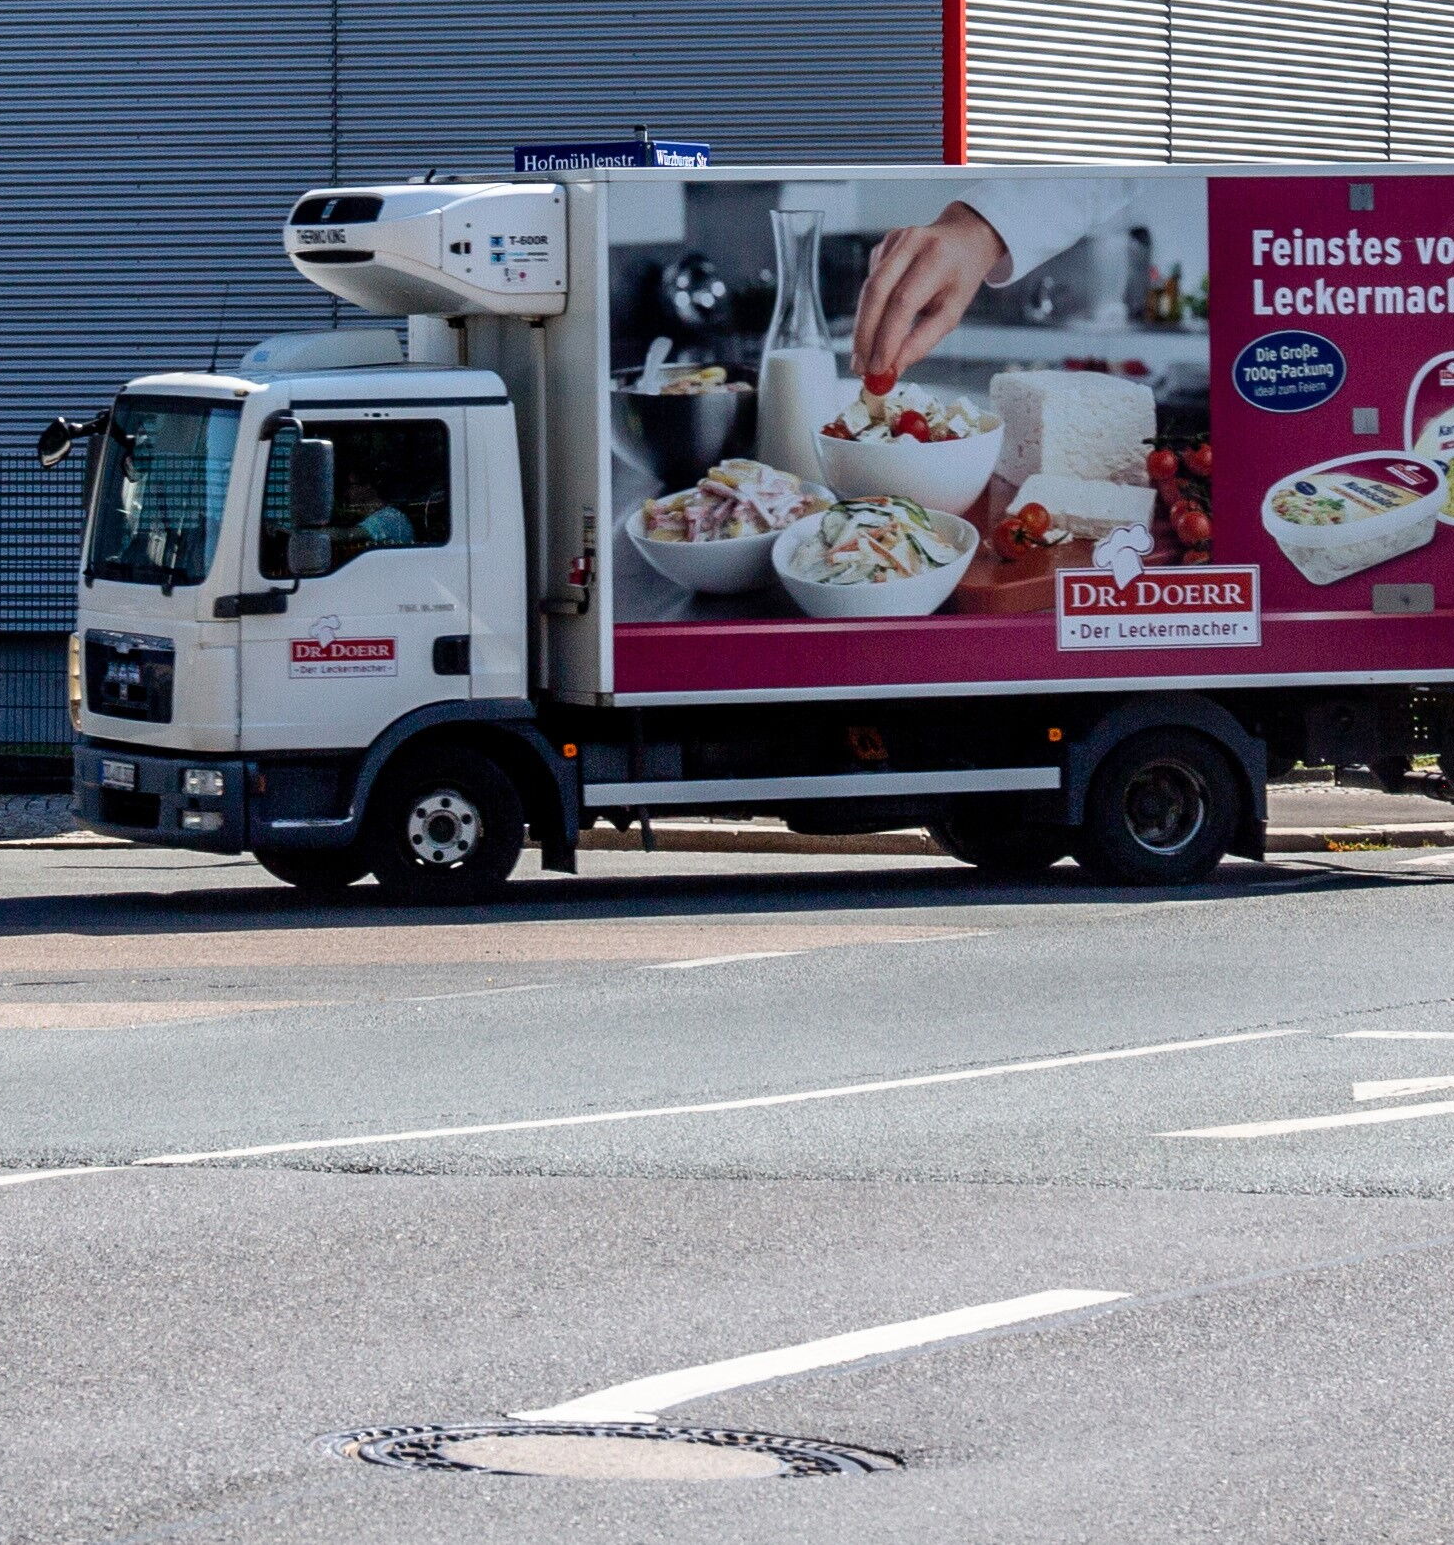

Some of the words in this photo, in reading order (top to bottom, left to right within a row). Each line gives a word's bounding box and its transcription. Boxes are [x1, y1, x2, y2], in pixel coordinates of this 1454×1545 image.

[523, 152, 637, 172] Hofmühlenstr.
[508, 235, 549, 246] T-600R
[1252, 228, 1402, 266] Feinstes
[1256, 347, 1278, 363] Die
[1280, 343, 1319, 361] Große
[1243, 363, 1334, 383] 700g-Packung
[1278, 384, 1298, 395] zum
[1071, 583, 1127, 608] DR.
[1136, 582, 1245, 606] DOERR
[1080, 623, 1110, 639] Der
[1118, 620, 1238, 638] Leckermacher
[296, 644, 327, 658] DR.
[331, 643, 390, 657] DOERR
